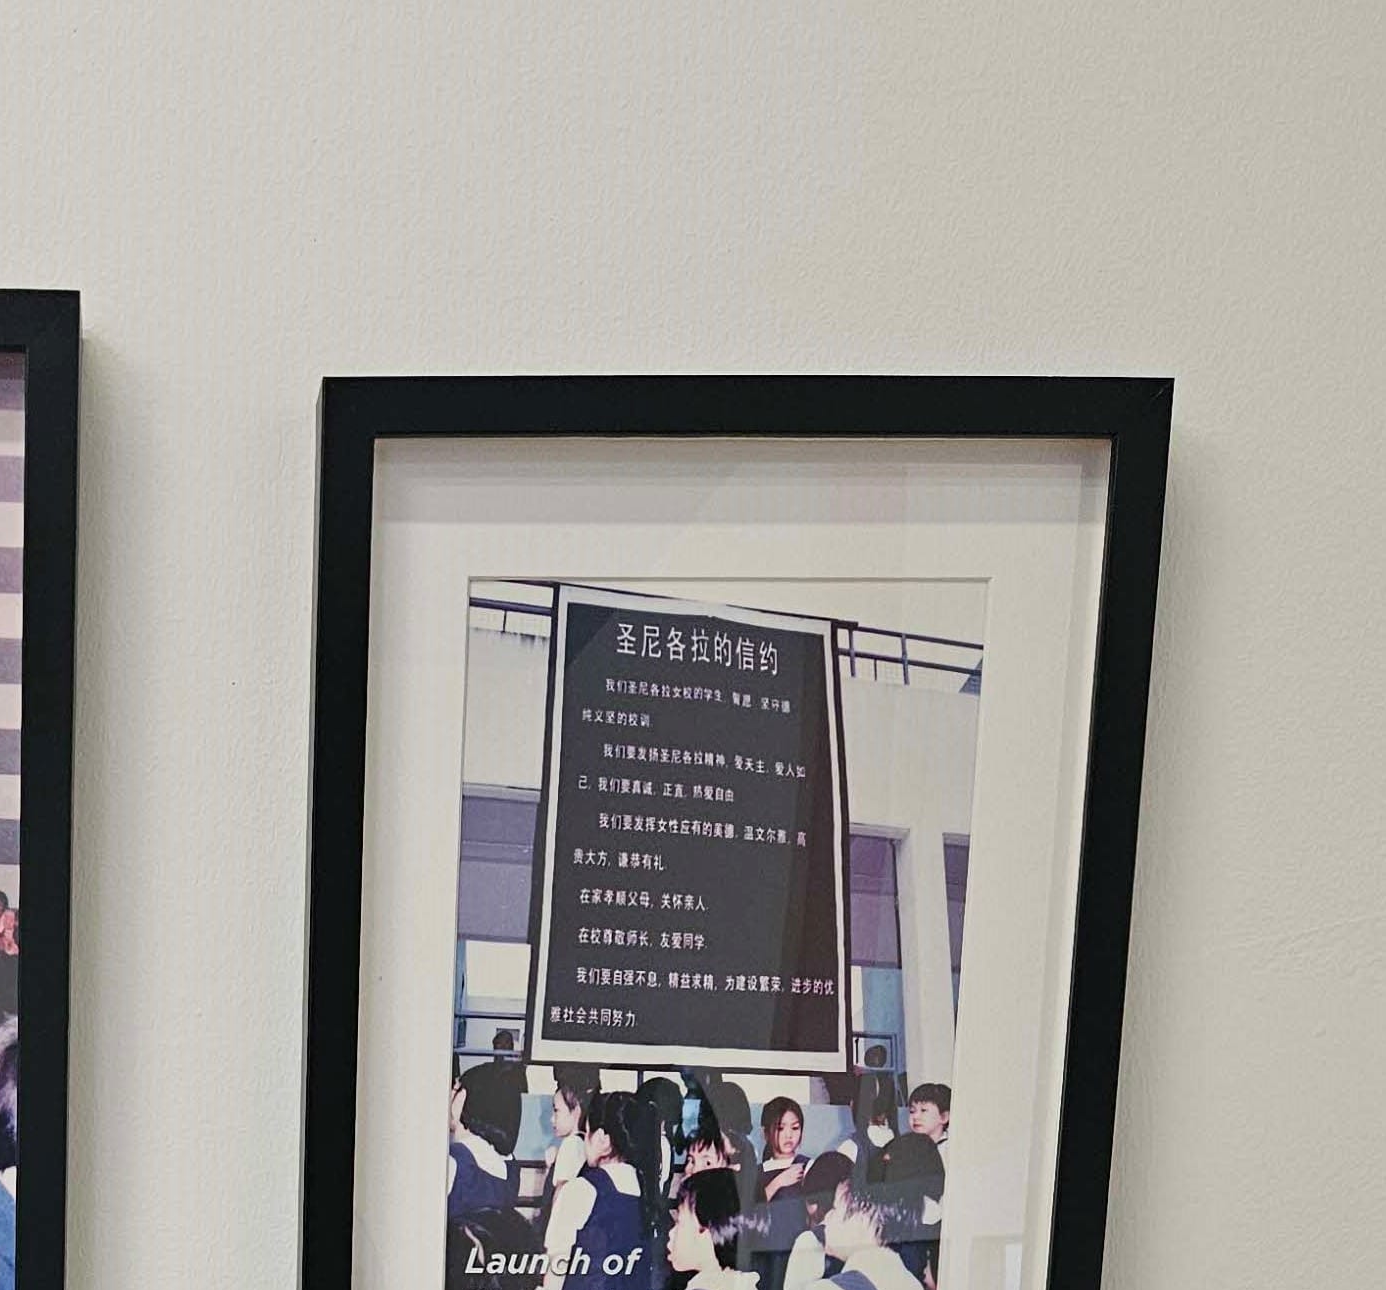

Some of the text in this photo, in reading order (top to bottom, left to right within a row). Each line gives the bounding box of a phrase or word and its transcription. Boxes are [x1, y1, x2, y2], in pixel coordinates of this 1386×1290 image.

[616, 623, 779, 676] 圣尼各拉的信约
[464, 1247, 644, 1276] Launch of
